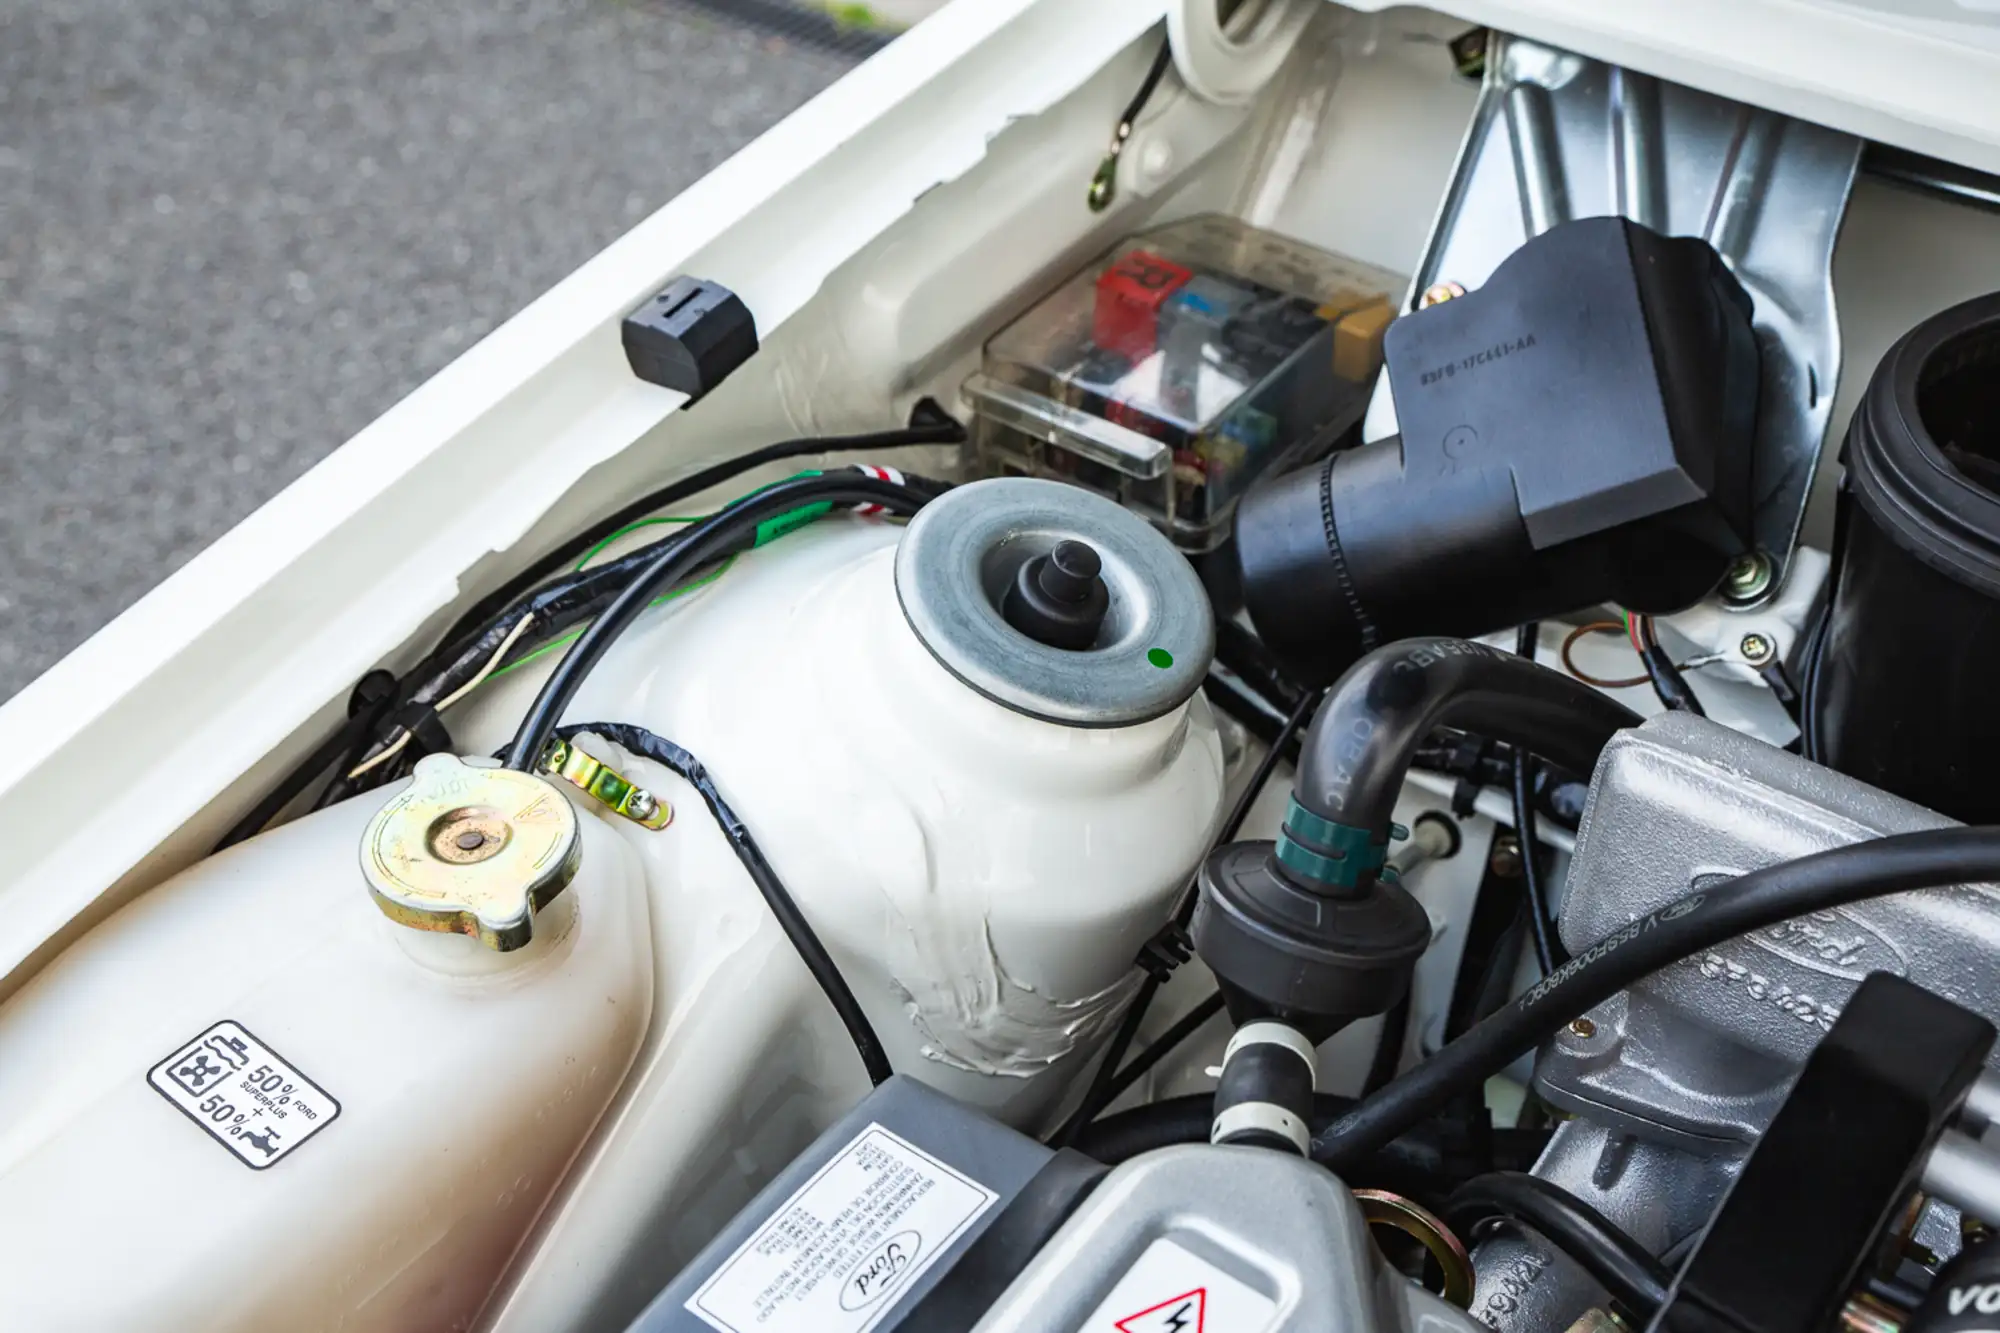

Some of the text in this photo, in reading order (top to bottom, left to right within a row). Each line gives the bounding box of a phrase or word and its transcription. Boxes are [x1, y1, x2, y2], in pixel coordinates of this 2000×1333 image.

[199, 1094, 249, 1135] 50%
[240, 1081, 287, 1119] SUPERPLUS
[248, 1065, 317, 1119] 50% FORD
[847, 1210, 865, 1229] DEL
[851, 1194, 865, 1209] DE
[788, 1206, 854, 1272] REMPLACEMENT
[798, 1227, 849, 1278] VENTILADOR
[831, 1176, 935, 1280] REPLACEMENT BELT FITTED
[847, 1217, 877, 1247] WURDE
[793, 1245, 850, 1302] GEWECHSELT
[855, 1242, 907, 1296] Ford
[754, 1276, 802, 1324] INSTALADO
